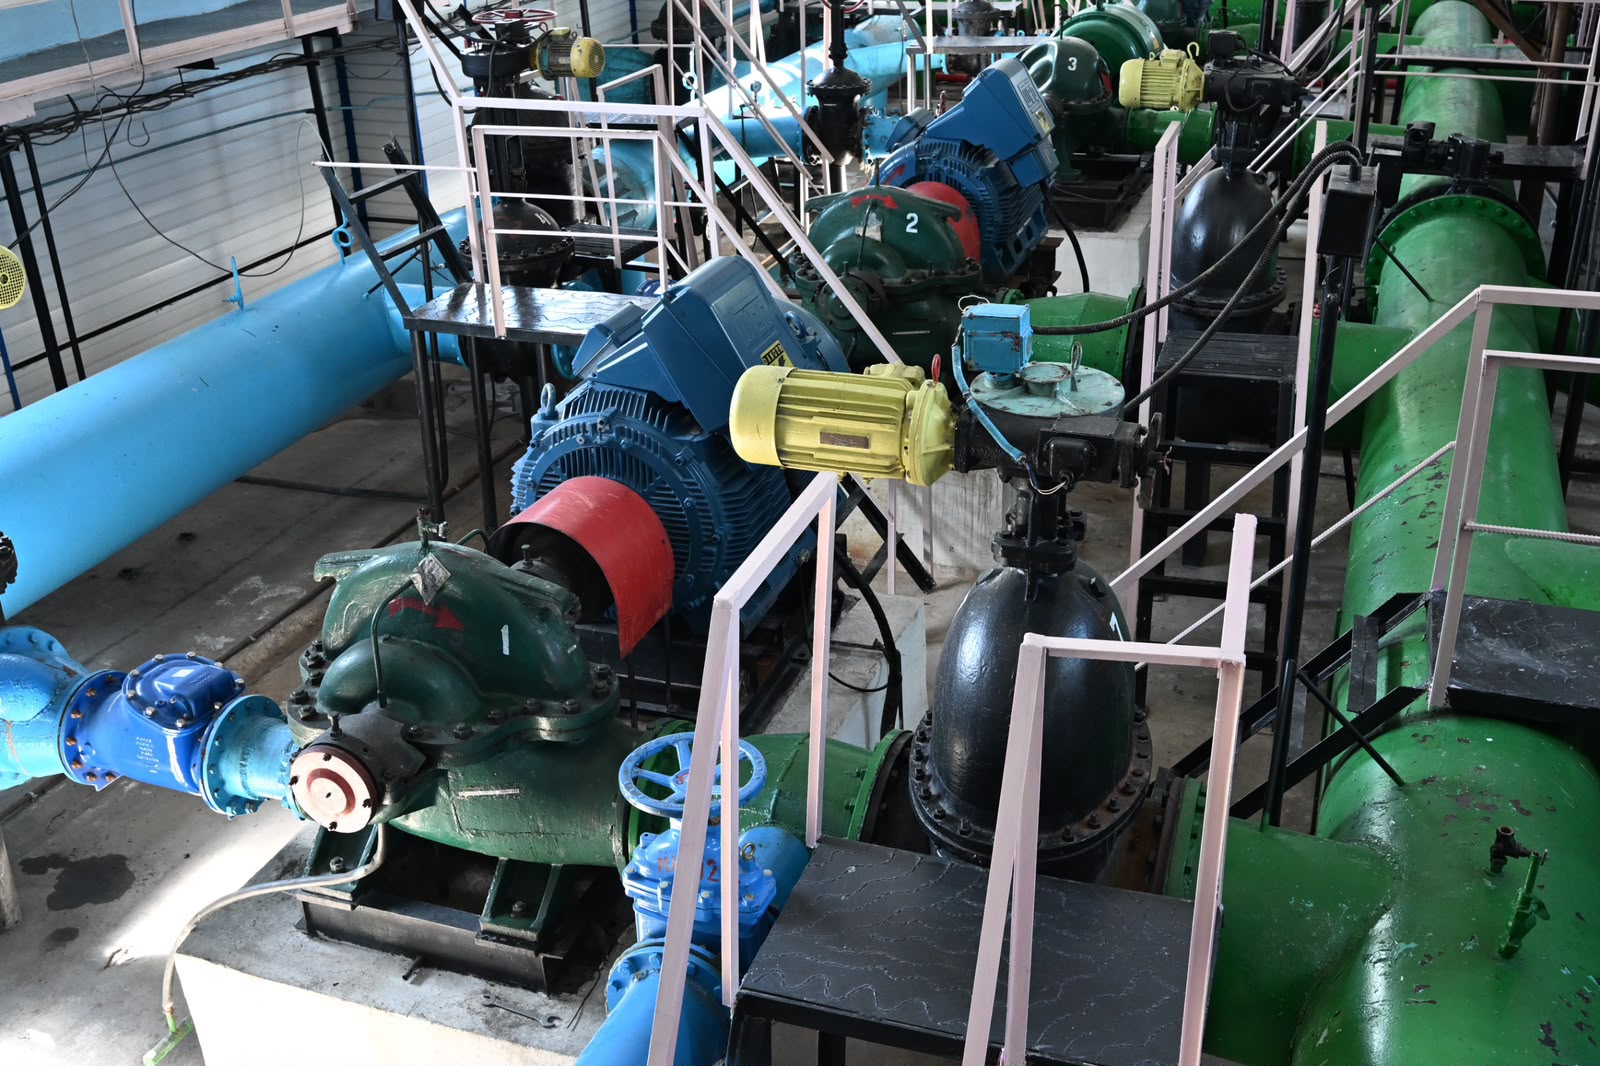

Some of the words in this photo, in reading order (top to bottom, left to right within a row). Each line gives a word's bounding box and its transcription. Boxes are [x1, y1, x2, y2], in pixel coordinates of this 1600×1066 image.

[1067, 56, 1078, 71] 3
[905, 212, 919, 234] 2
[500, 624, 510, 656] 1
